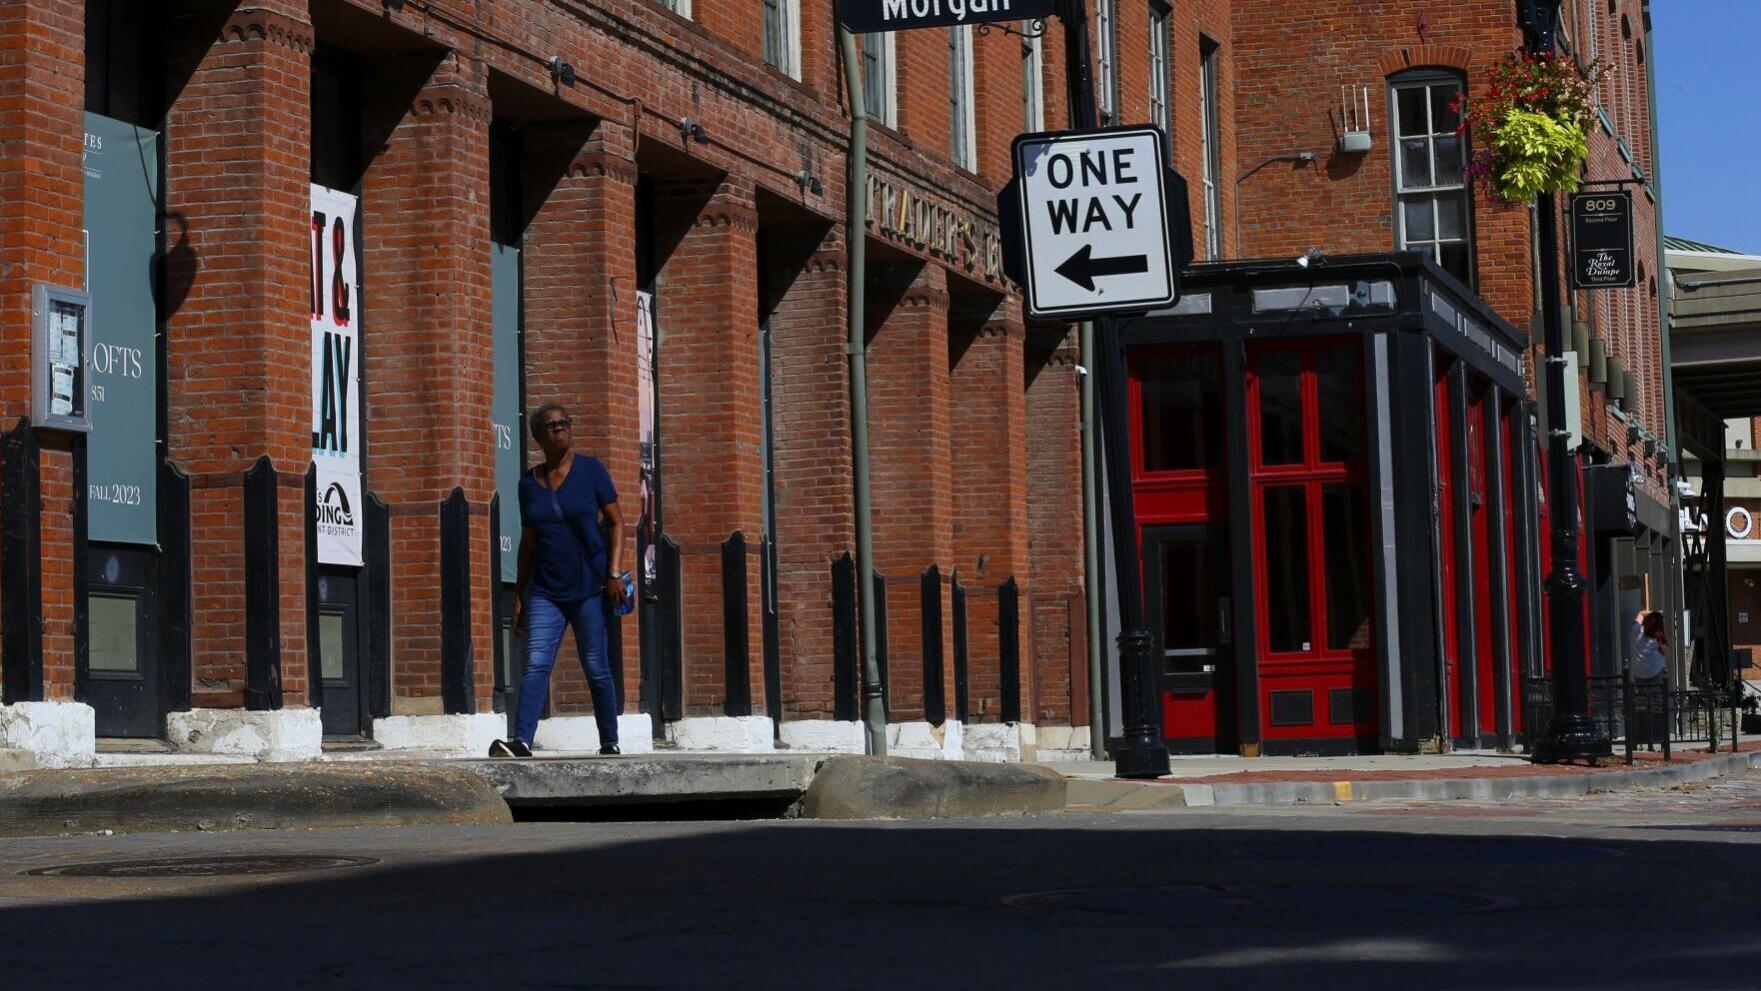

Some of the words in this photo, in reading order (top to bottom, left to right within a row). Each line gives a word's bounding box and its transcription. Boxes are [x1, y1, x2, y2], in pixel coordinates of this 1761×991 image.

[1047, 148, 1138, 189] ONE
[1585, 199, 1616, 211] 809
[1046, 193, 1142, 235] WAY
[1596, 252, 1613, 261] The
[1588, 258, 1615, 271] Royal
[1586, 267, 1620, 276] Dumpe
[91, 342, 142, 379] OFTS
[89, 484, 110, 501] FALL
[112, 483, 141, 506] 2023
[327, 526, 355, 537] DISTRICT
